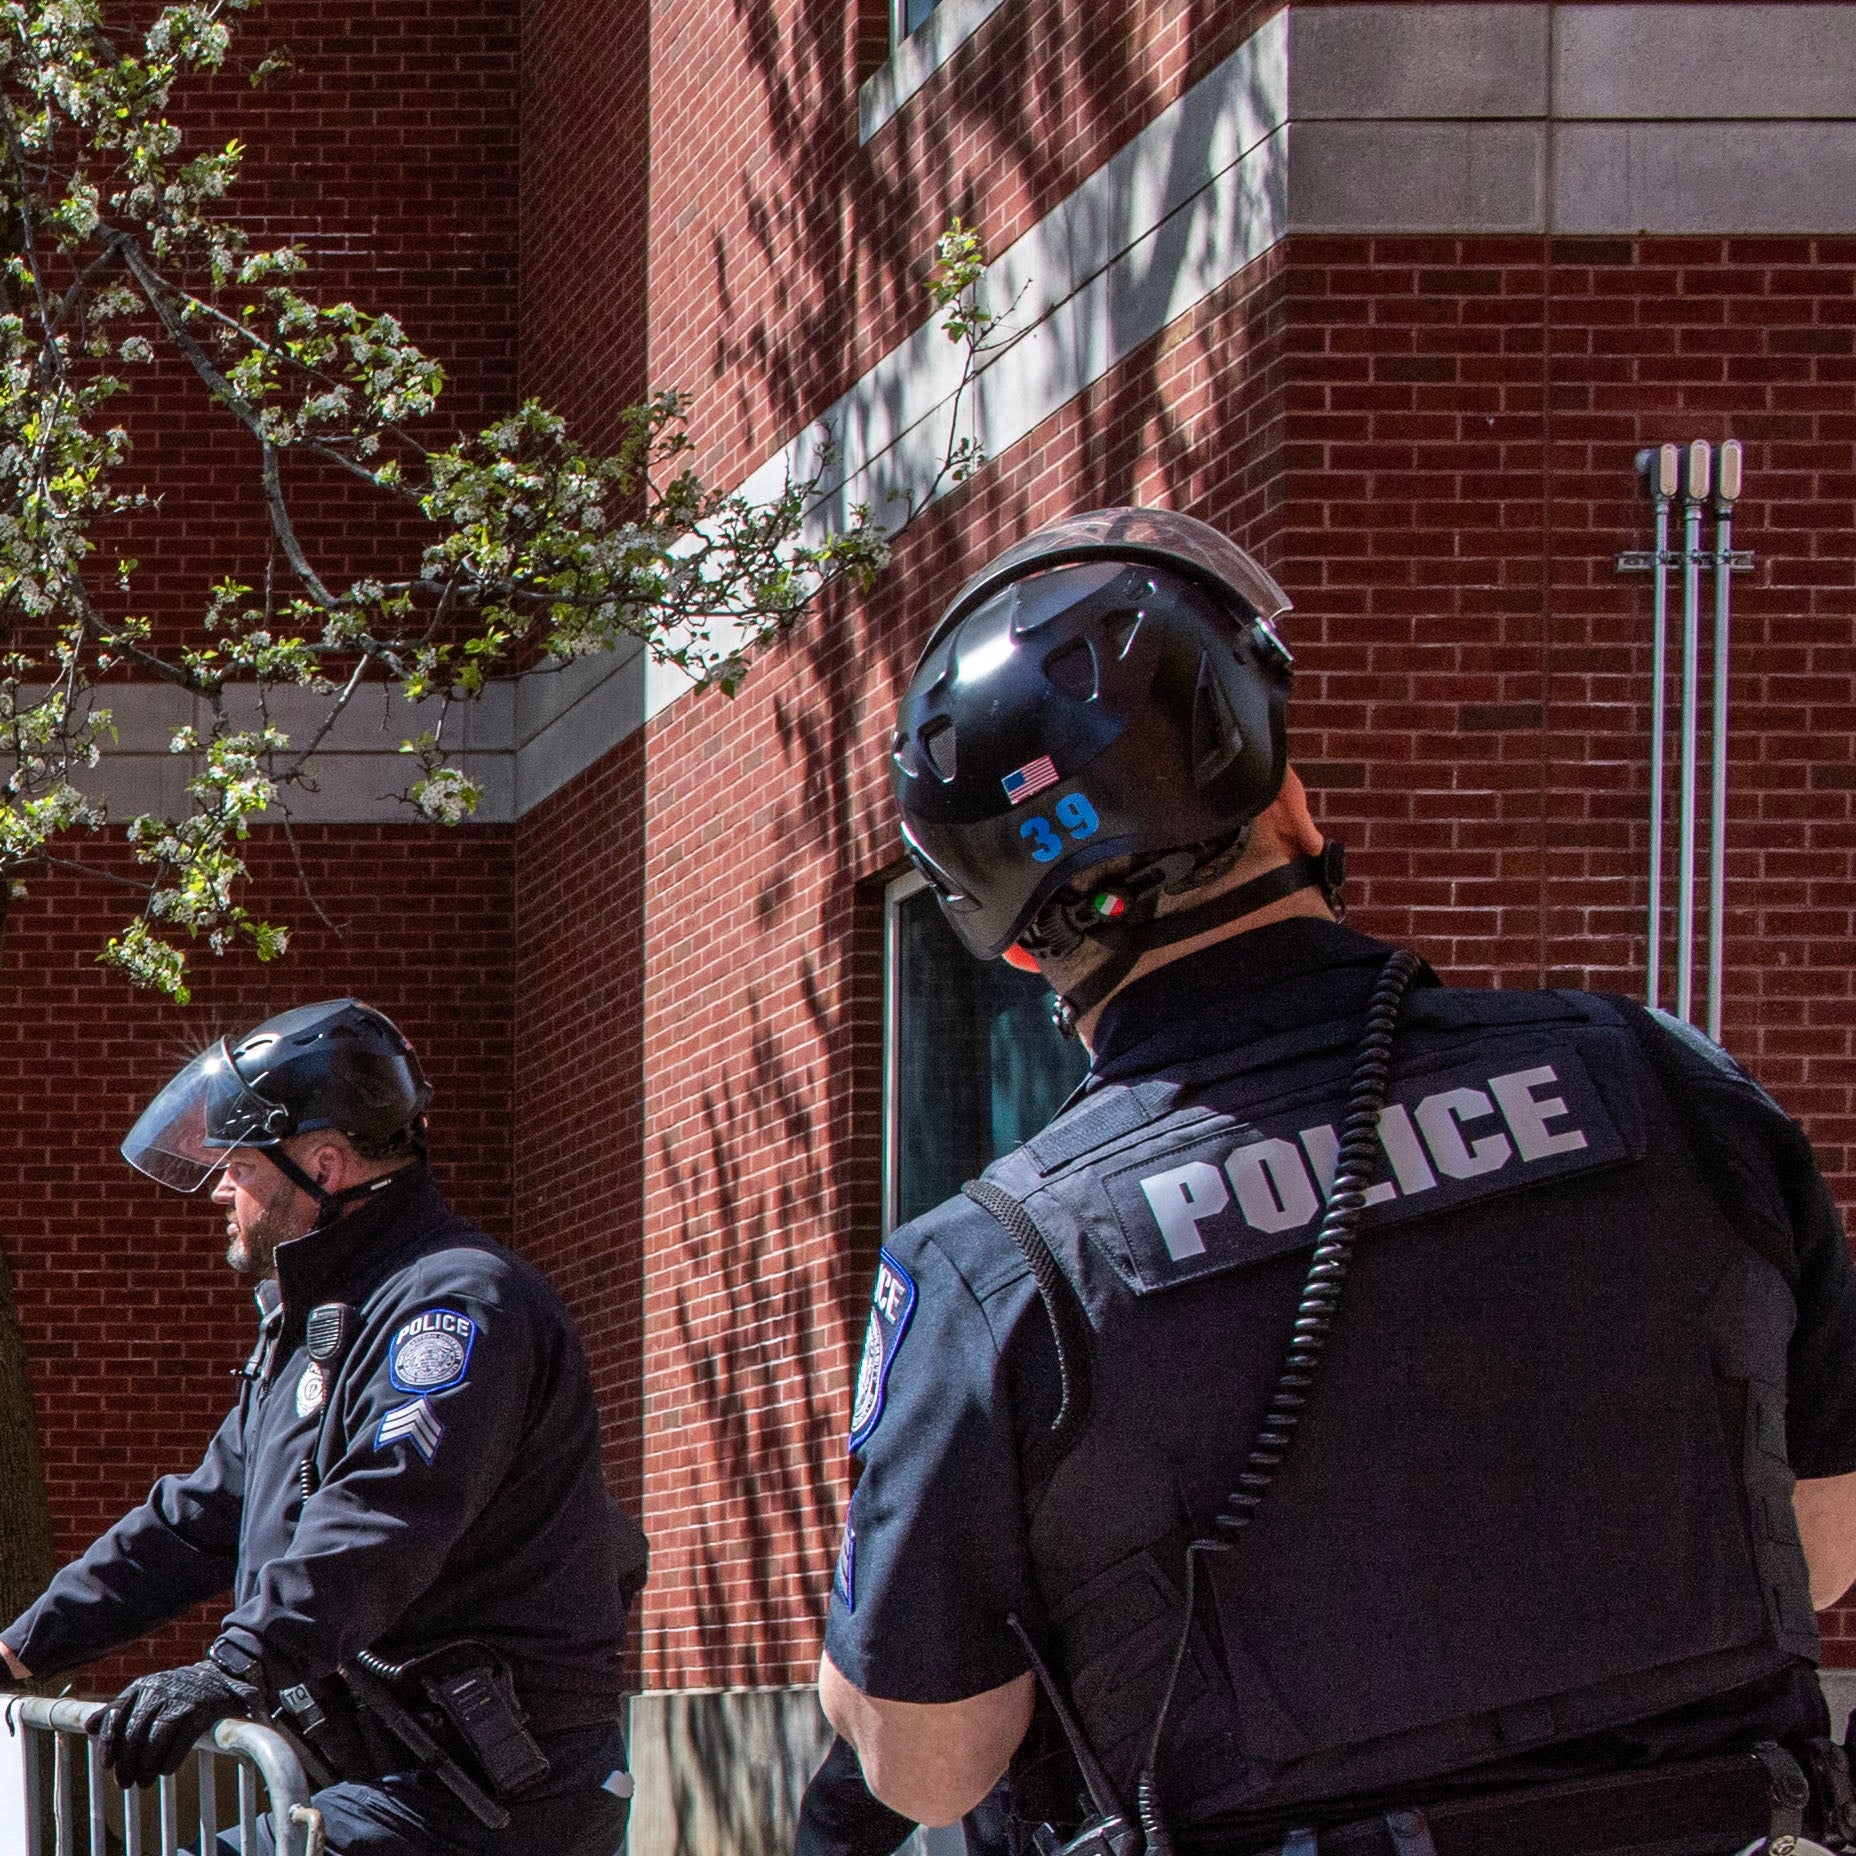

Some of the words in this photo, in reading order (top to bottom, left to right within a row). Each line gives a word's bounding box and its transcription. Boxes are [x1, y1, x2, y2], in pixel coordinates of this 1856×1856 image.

[1020, 793, 1099, 862] 39
[1139, 1065, 1588, 1262] POLICE
[396, 1314, 469, 1345] POLICE
